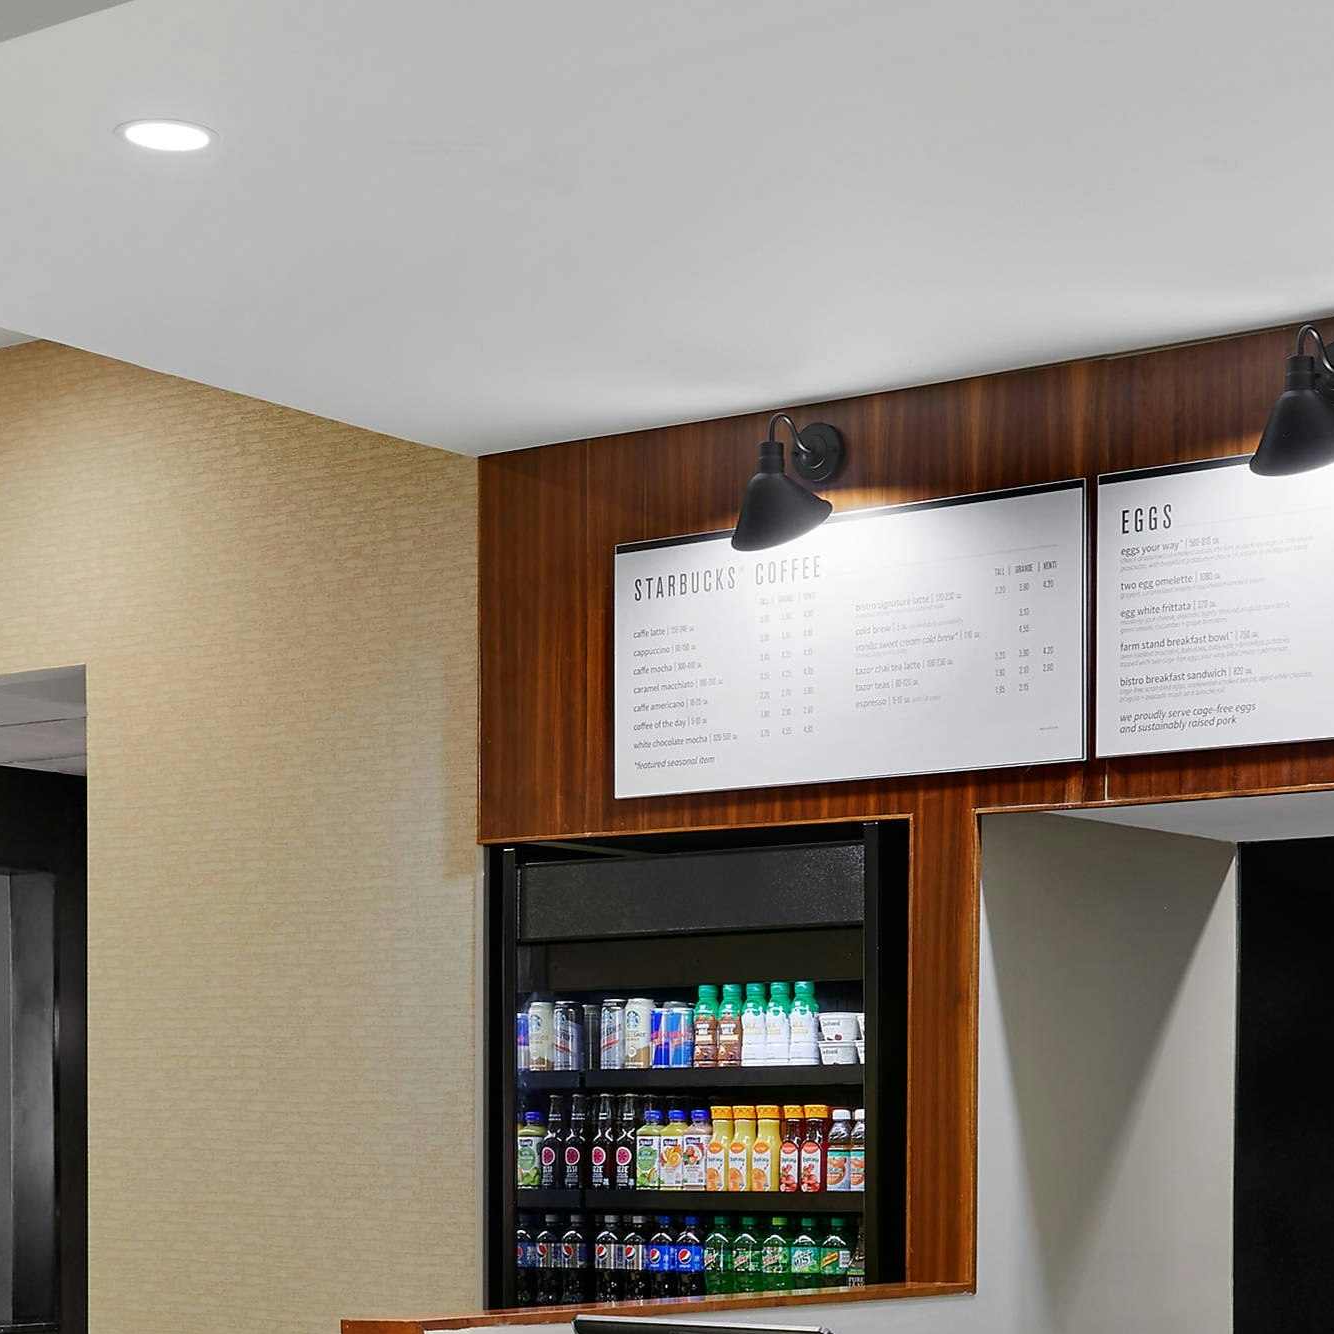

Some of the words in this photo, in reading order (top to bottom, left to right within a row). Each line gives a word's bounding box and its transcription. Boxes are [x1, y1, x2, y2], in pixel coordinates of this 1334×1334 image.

[1120, 503, 1173, 536] EGGS
[1120, 546, 1139, 558] eggs
[1141, 543, 1159, 555] your
[634, 566, 737, 602] STARBUCKS
[755, 555, 821, 586] COFFEE
[1120, 580, 1136, 590] two
[1137, 580, 1153, 590] egg
[1154, 574, 1192, 586] omelette
[1120, 608, 1136, 619] egg
[1137, 604, 1160, 616] white
[1161, 600, 1191, 613] frittata
[650, 626, 665, 636] latte
[855, 625, 870, 636] cold
[872, 623, 891, 634] brew
[1120, 640, 1139, 651] farm
[1141, 638, 1165, 649] stand
[1166, 633, 1206, 647] breakfast
[633, 644, 670, 659] cappuccino
[650, 663, 672, 673] mocha
[891, 662, 903, 672] tea
[904, 660, 921, 670] latte
[1120, 675, 1144, 686] bistro
[1145, 671, 1185, 684] breakfast
[1186, 667, 1226, 680] sandwich
[633, 683, 659, 694] caramel
[661, 679, 694, 691] macchiato
[874, 680, 890, 690] teas
[650, 699, 684, 710] americano
[855, 698, 887, 711] espresso
[1119, 714, 1132, 722] we
[1133, 709, 1166, 722] proudly
[1167, 708, 1191, 718] serve
[1192, 703, 1233, 717] cage-free
[1234, 703, 1256, 713] eggs
[633, 721, 654, 731] coffee
[654, 720, 661, 729] of
[662, 719, 673, 728] the
[673, 717, 686, 729] day
[1119, 723, 1136, 733] and
[1137, 719, 1186, 734] sustainably
[1187, 716, 1215, 727] raised
[1215, 714, 1236, 727] pork
[633, 739, 651, 749] white
[652, 736, 683, 747] chocolate
[685, 734, 707, 744] mocha
[667, 756, 698, 767] seasonal
[698, 754, 715, 764] item
